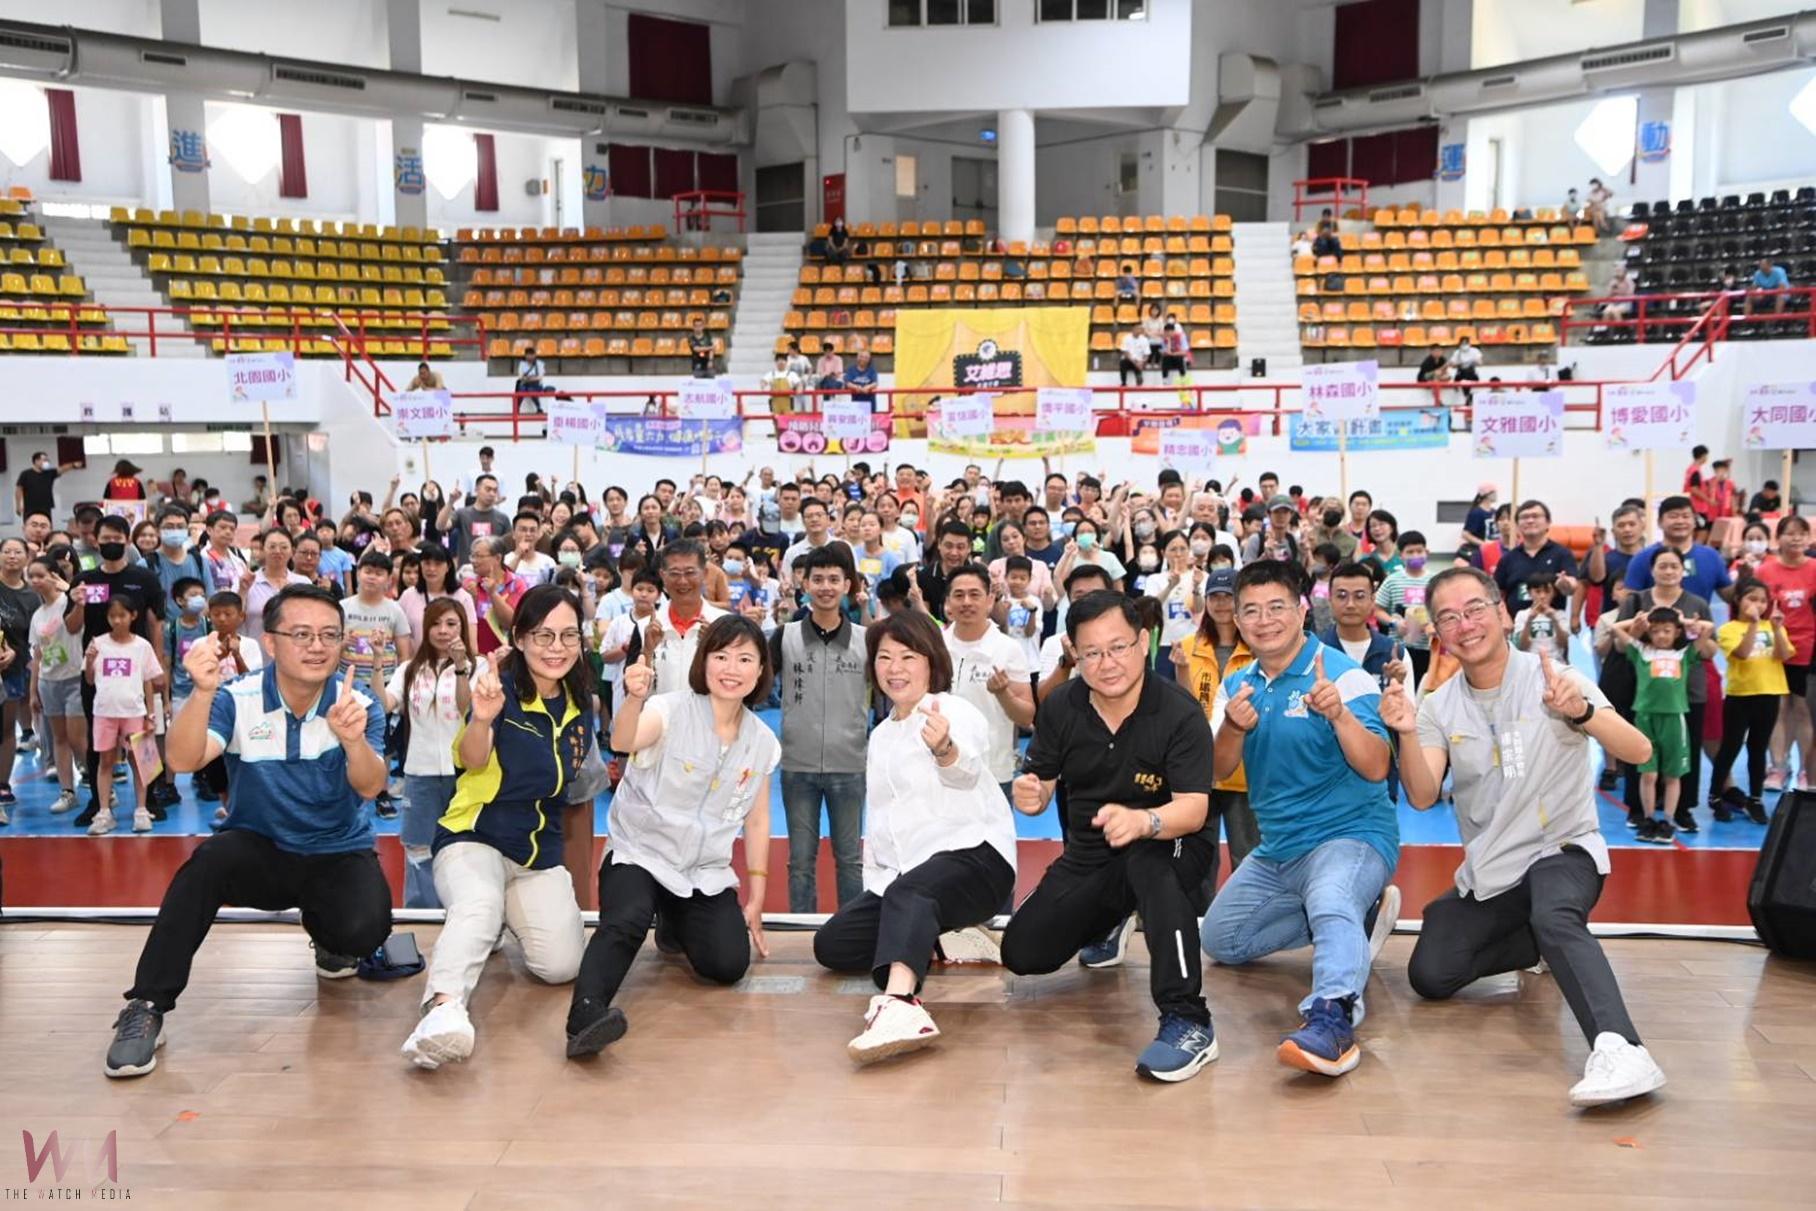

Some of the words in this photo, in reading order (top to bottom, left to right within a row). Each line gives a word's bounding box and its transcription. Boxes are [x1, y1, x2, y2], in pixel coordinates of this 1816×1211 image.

[172, 129, 205, 163] 進
[1641, 121, 1669, 153] 動
[396, 156, 425, 186] 活
[583, 164, 610, 197] 力
[1309, 382, 1372, 399] 林森國小
[396, 406, 448, 421] 崇文國小
[1481, 415, 1557, 434] 文雅國小
[1610, 405, 1688, 425] 博愛國小
